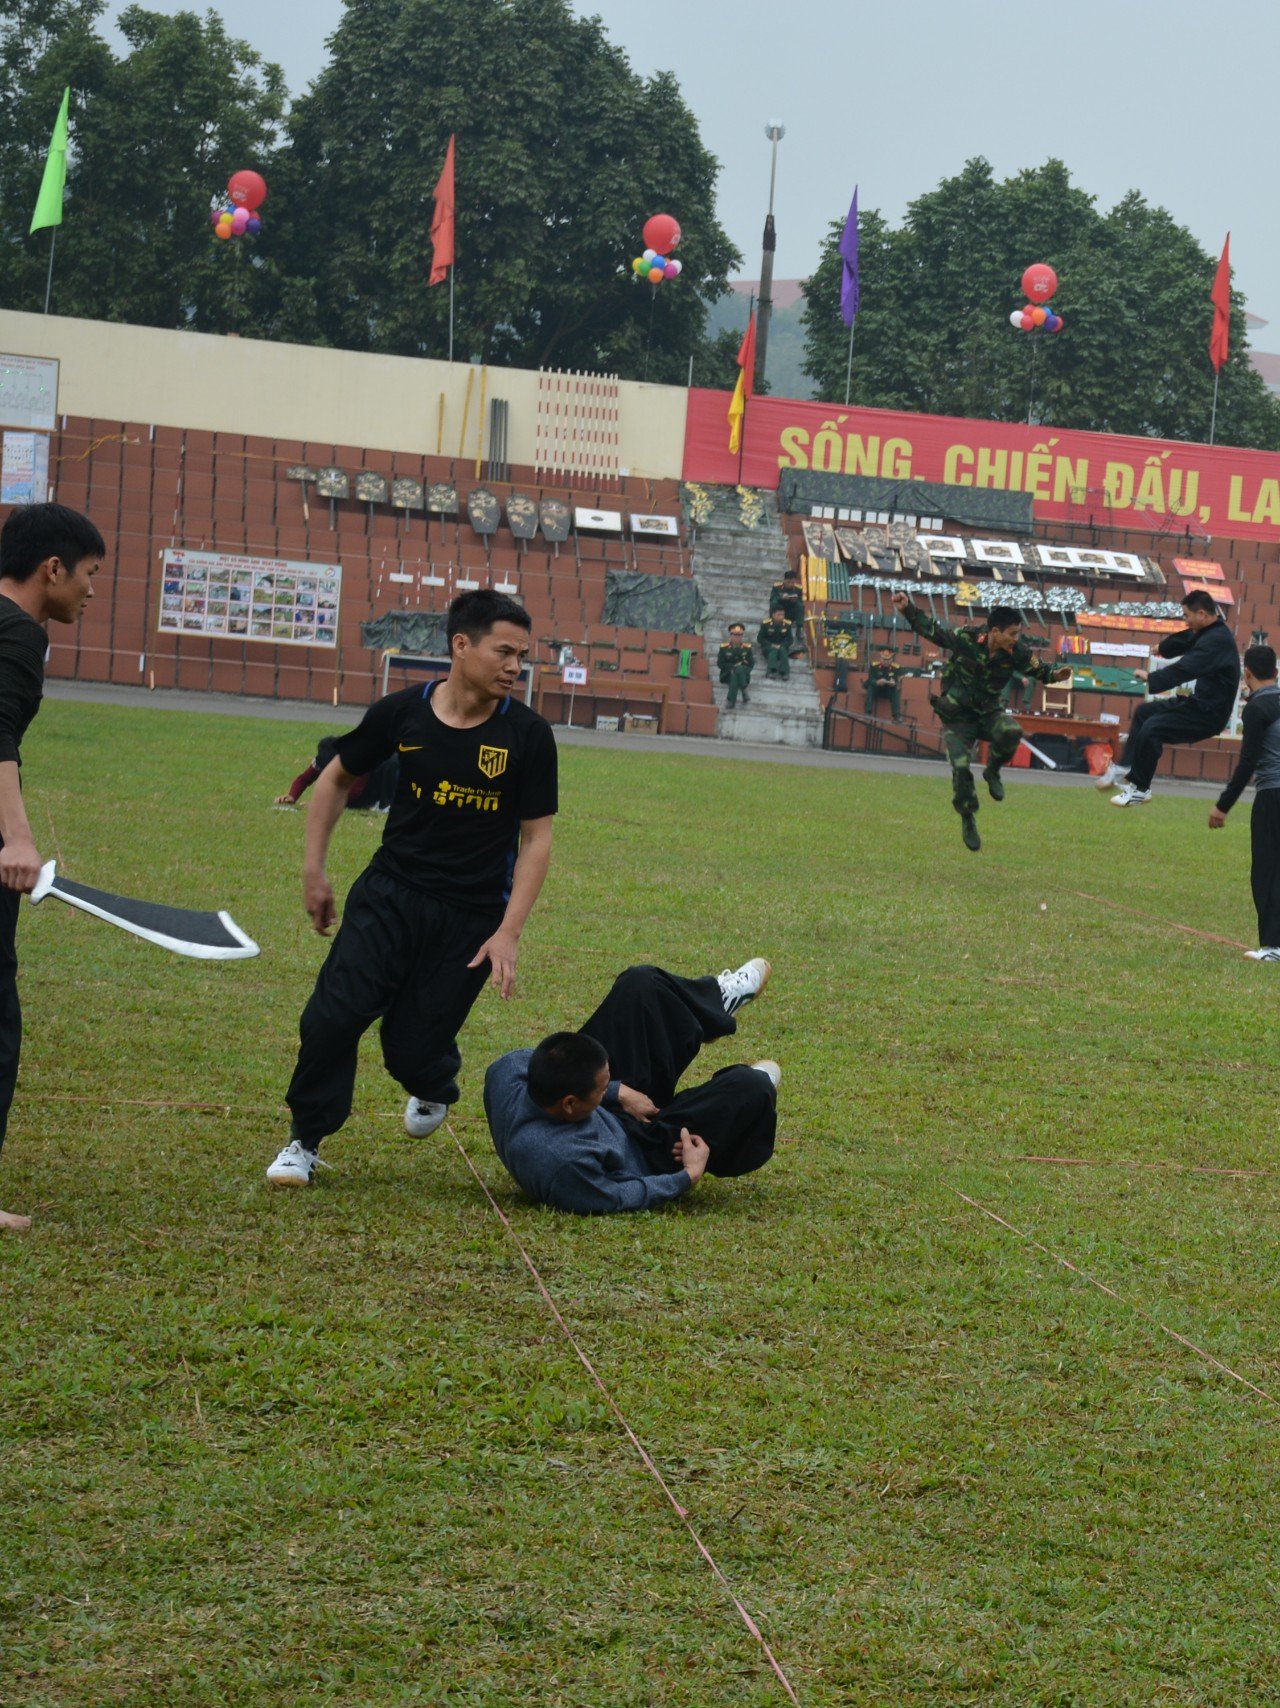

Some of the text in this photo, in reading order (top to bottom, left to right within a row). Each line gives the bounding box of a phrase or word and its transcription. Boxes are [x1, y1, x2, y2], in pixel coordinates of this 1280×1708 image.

[777, 415, 926, 481] SỐNG
[943, 438, 1089, 505] CHIẾN
[1102, 451, 1211, 524] ĐẤU,
[452, 784, 475, 795] Trade
